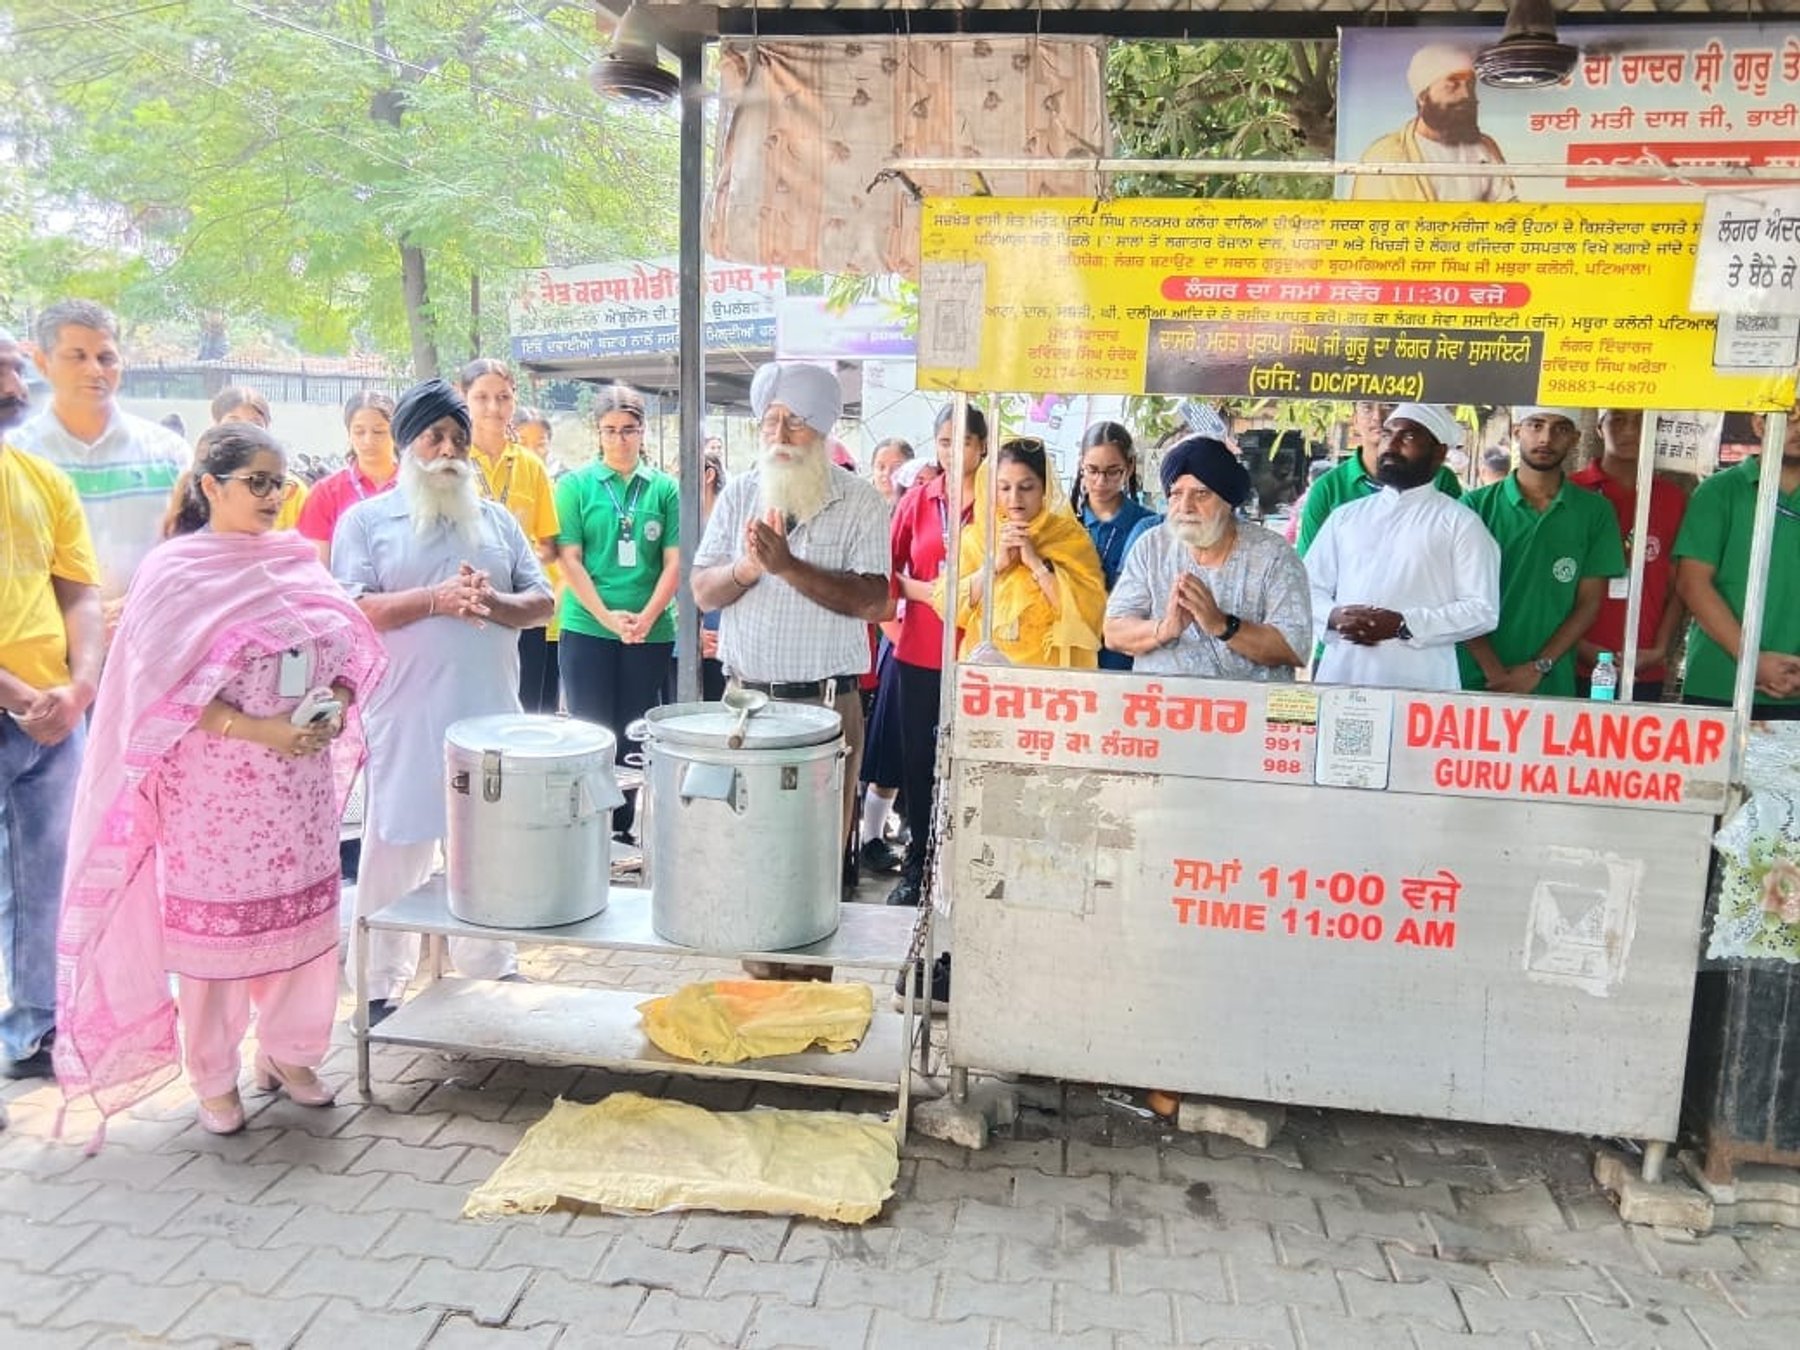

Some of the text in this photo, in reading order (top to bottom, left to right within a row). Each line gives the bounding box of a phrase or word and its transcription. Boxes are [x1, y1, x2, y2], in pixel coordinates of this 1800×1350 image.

[1622, 53, 1685, 84] ਚਾਦਰ
[1733, 52, 1773, 96] ਗੁਰੂ
[1530, 103, 1799, 132] ਭਾਈ ਮਤੀ ਦਾਸ ਜੀ, ਭਾਈ
[1718, 211, 1761, 243] ਲੰਗਰ
[1727, 254, 1743, 288] ਤੇ
[1781, 256, 1797, 290] ਕੇ
[1183, 278, 1239, 300] ਲੰਗਰ
[1246, 283, 1271, 300] ਦਾ
[1392, 285, 1460, 306] 11:30
[1468, 284, 1507, 305] ਵਜੇ
[1658, 315, 1718, 332] ਪਟਿਆਲ
[1289, 327, 1319, 356] ਸਿੰਘ
[1324, 329, 1341, 357] ਜੀ
[1345, 337, 1369, 365] ਗੁਰੂ
[1374, 337, 1391, 358] ਦਾ
[1395, 330, 1432, 359] ਲੰਗਰ
[1435, 332, 1465, 360] ਸੇਵਾ
[1468, 334, 1531, 366] ਸੁਸਾਇਟੀ
[1310, 371, 1424, 402] DIC/PTA/342)
[1123, 683, 1248, 734] ਲੰਗਰ
[1017, 729, 1055, 761] ਗੁਰੂ
[1066, 732, 1091, 754] ਕਾ
[1101, 729, 1159, 759] ਲੰਗਰ
[1265, 737, 1301, 752] 991
[1406, 702, 1725, 765] DAILY LANGAR
[1264, 759, 1301, 774] 988
[1435, 757, 1682, 801] GURU KA LANGAR
[1173, 858, 1243, 893] ਸਮਾਂ
[1400, 870, 1462, 912] ਵਜੇ
[1172, 898, 1456, 948] TIME 11:00 AM
